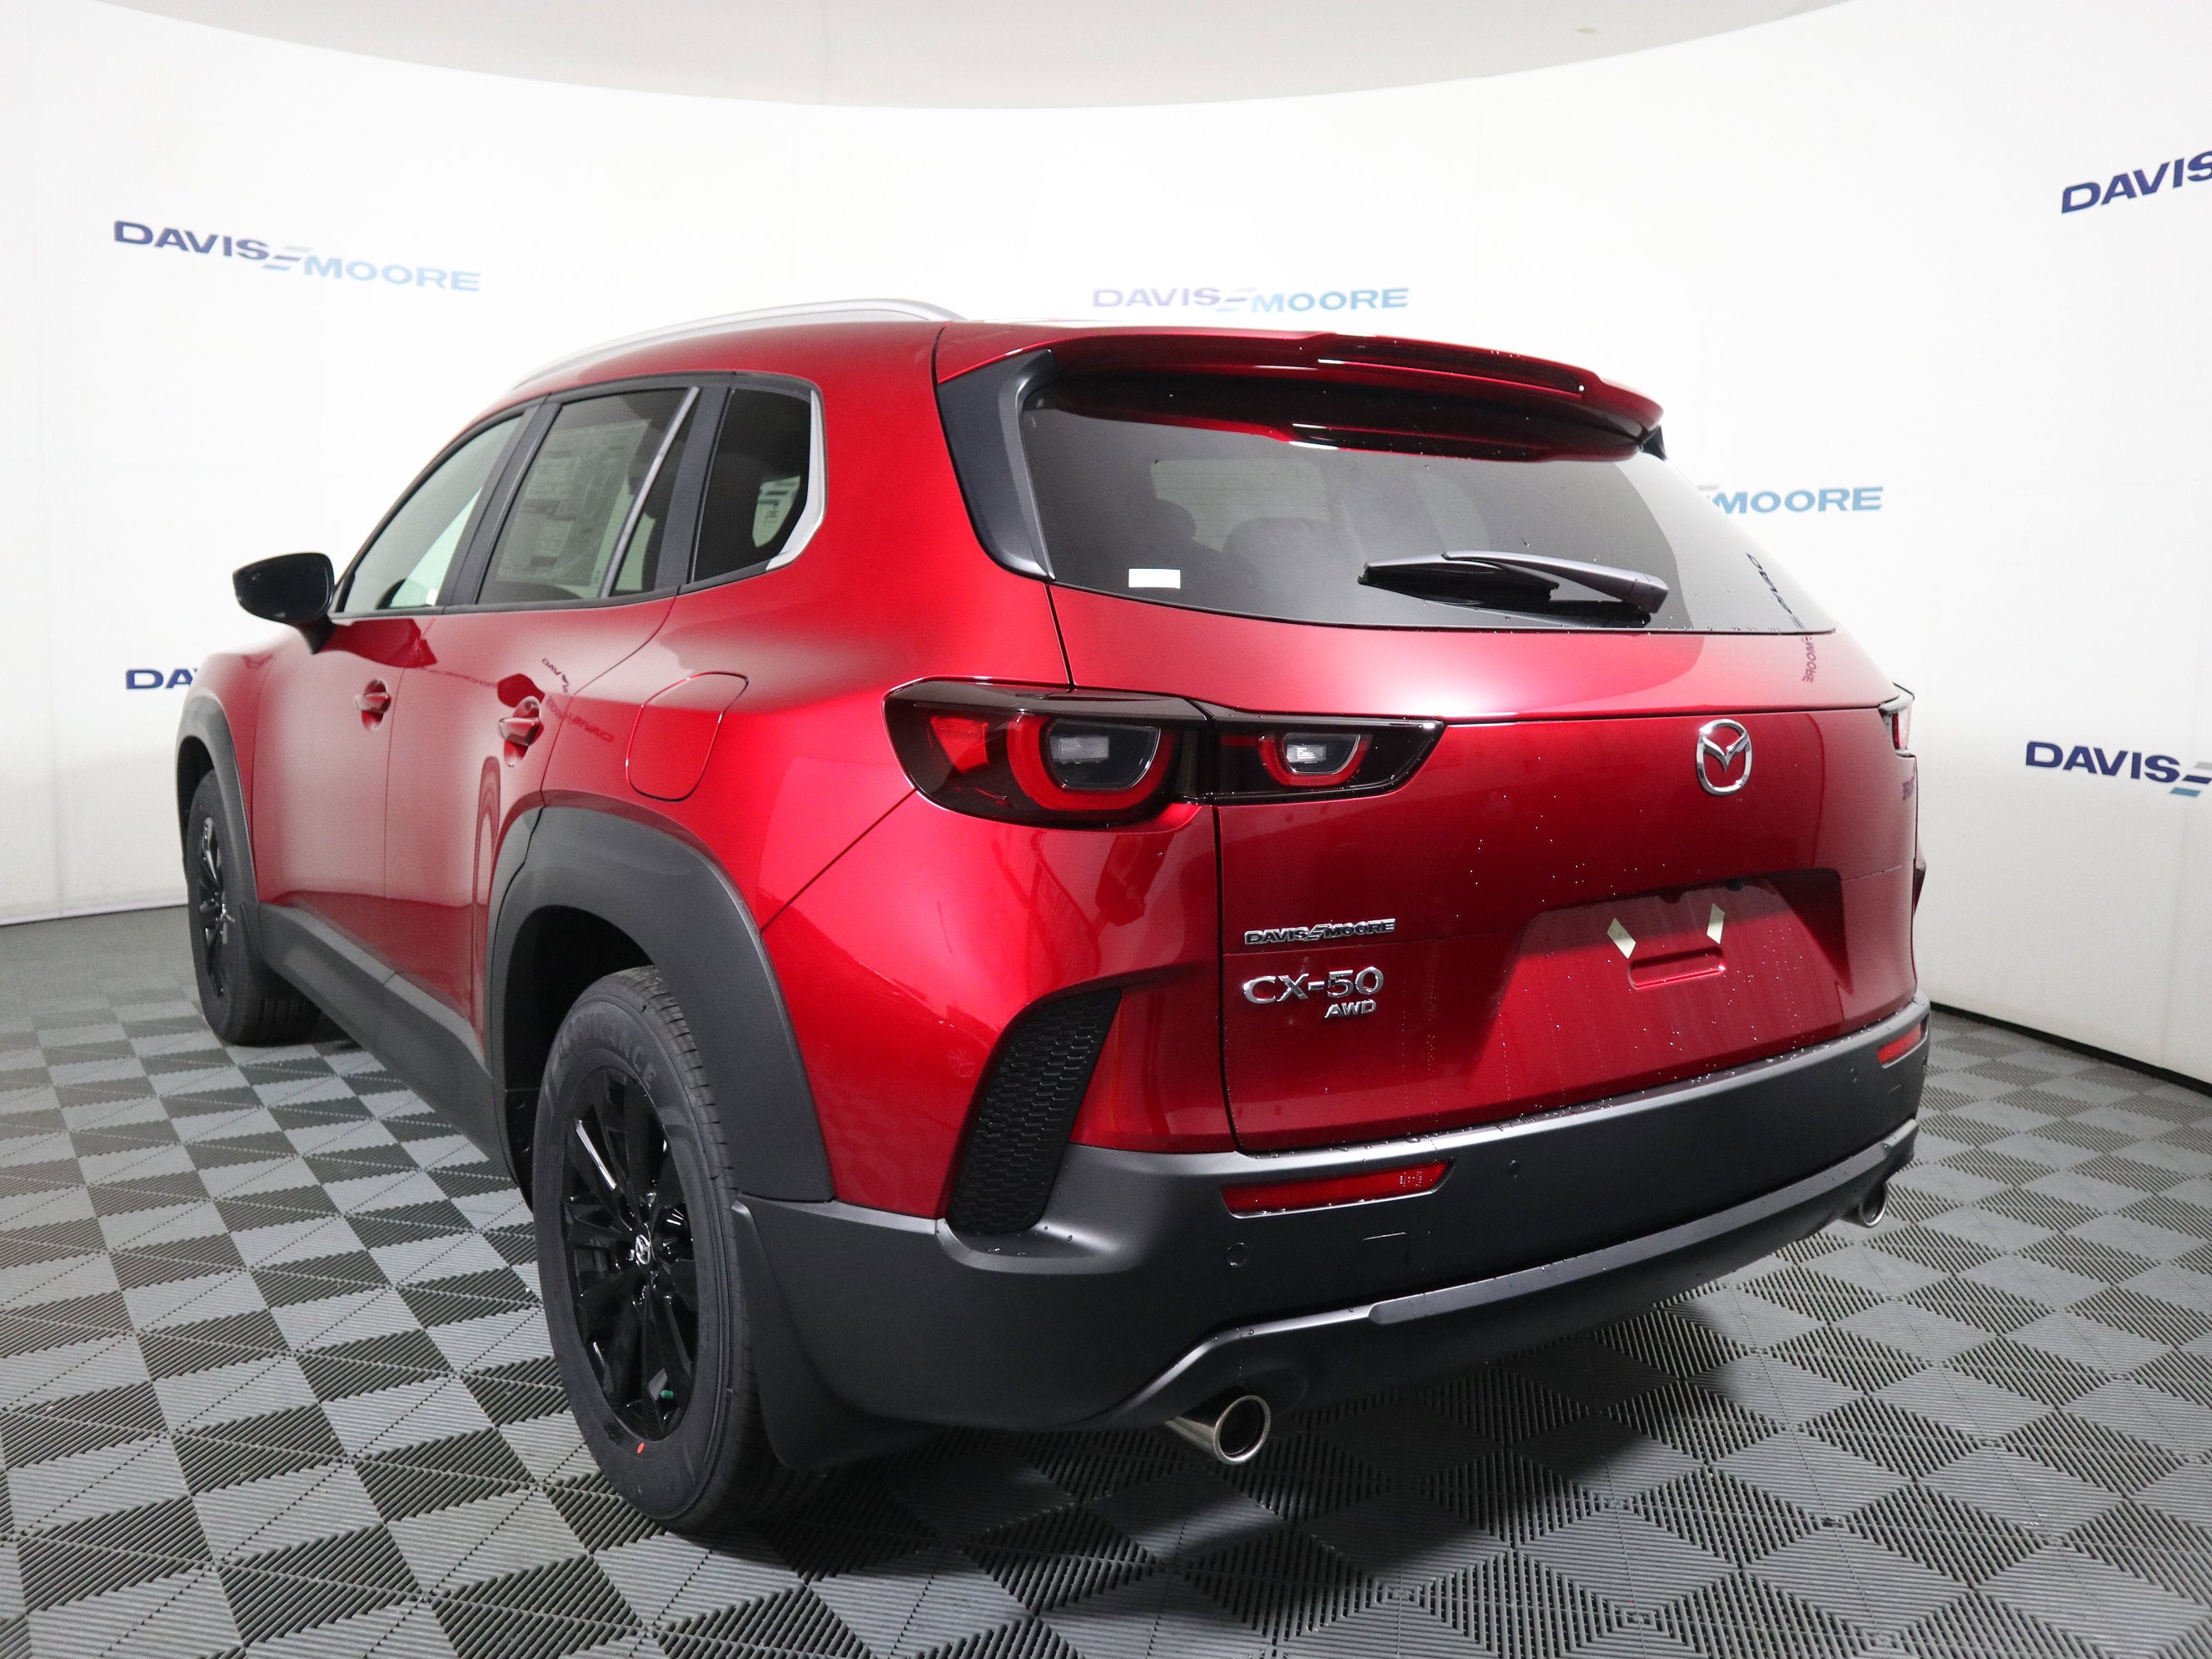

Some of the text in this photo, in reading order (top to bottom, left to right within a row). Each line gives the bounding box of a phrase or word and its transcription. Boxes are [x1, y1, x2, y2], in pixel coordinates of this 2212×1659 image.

[2061, 150, 2212, 214] DAVIS
[113, 220, 481, 292] DAVIS MOORE
[1093, 286, 1410, 313] DAVIS MOORE
[1711, 486, 1884, 515] MOORE
[126, 668, 197, 690] DA
[2025, 740, 2183, 784] DAVIS
[1244, 918, 1397, 945] DAVIS MOORE
[1243, 966, 1385, 1004] CX-50
[1324, 999, 1378, 1019] AWD
